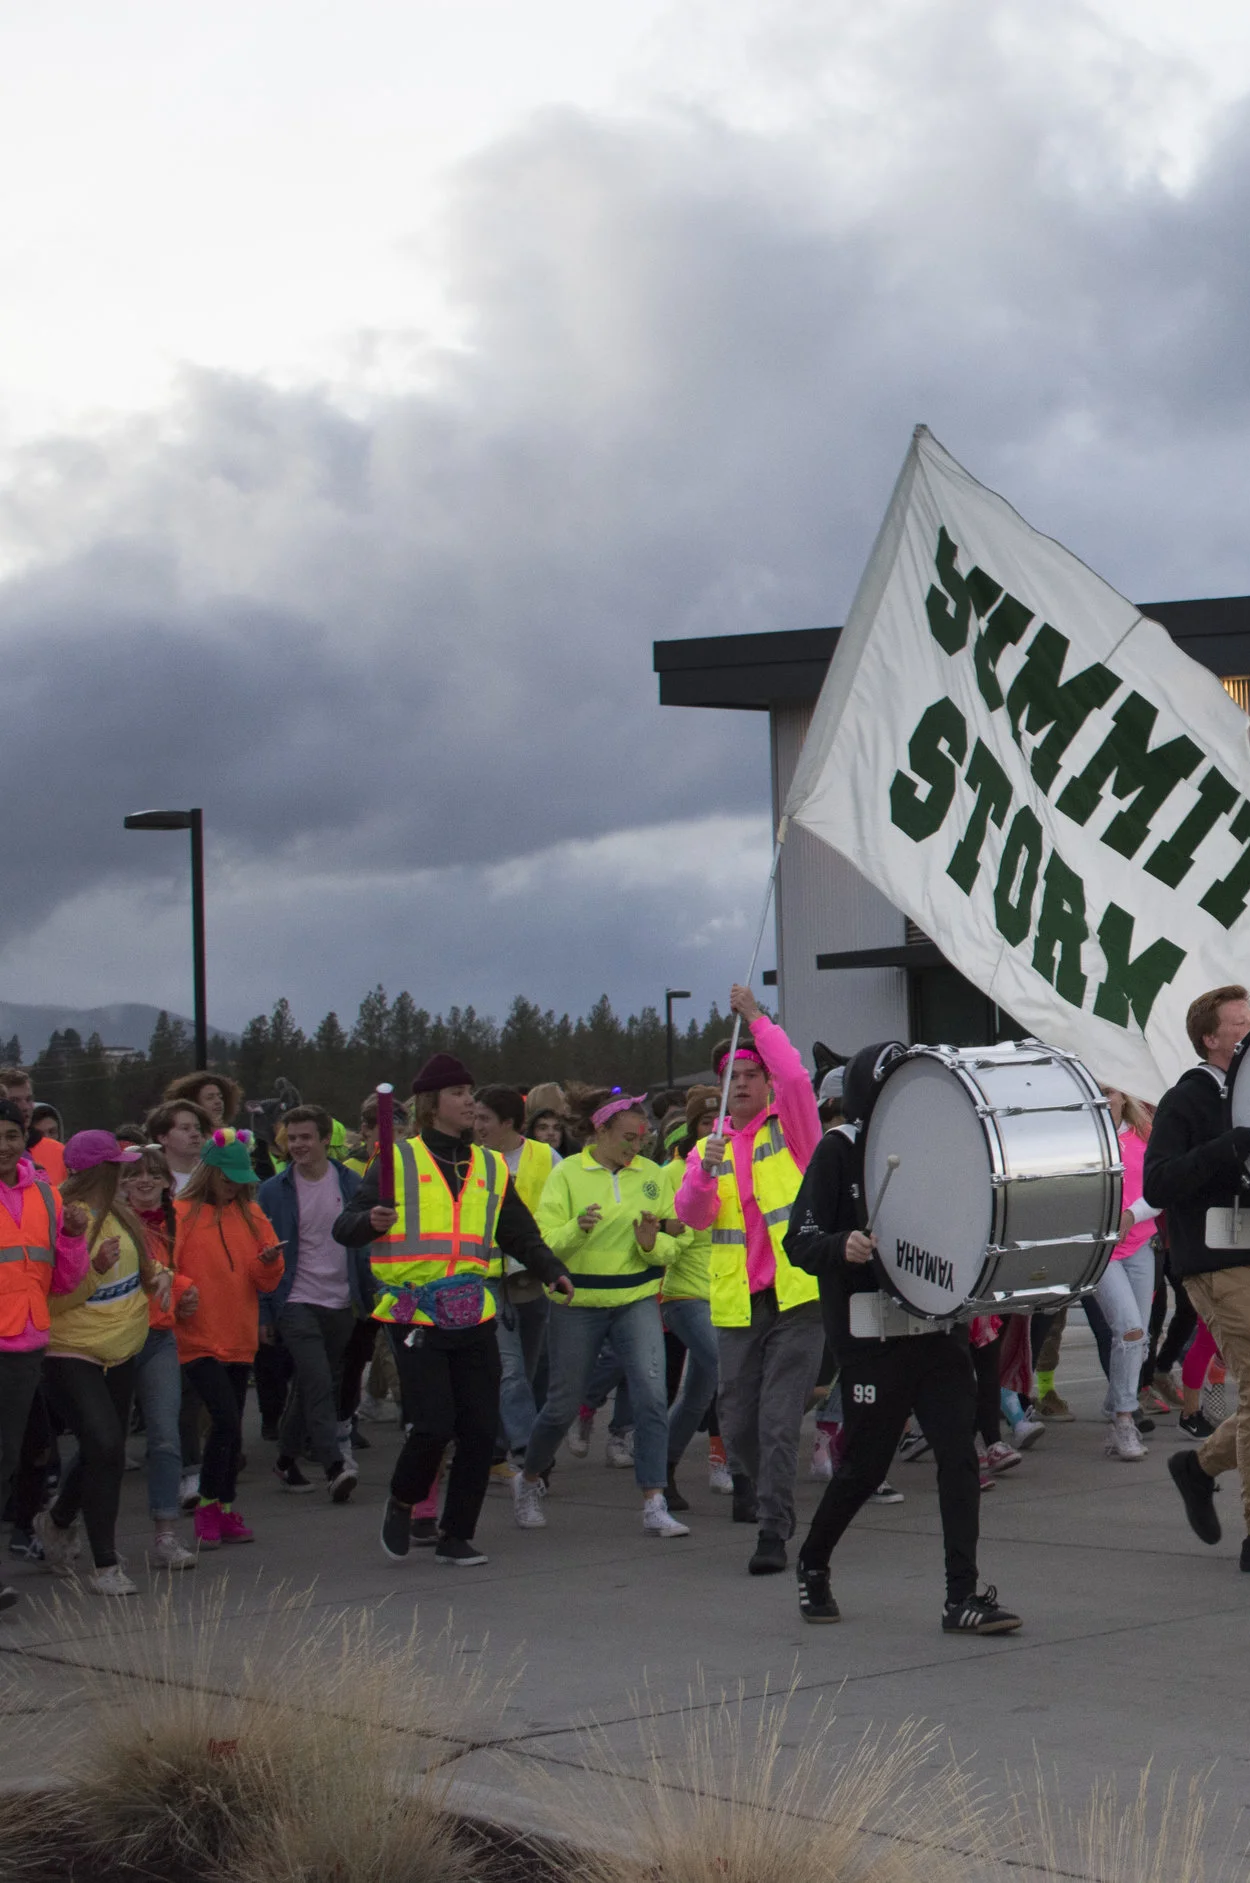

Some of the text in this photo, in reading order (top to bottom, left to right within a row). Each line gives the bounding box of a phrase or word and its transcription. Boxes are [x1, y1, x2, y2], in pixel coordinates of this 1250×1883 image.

[890, 696, 1187, 1039] STORM
[896, 1238, 954, 1292] YAMAHA
[853, 1383, 876, 1404] 99
